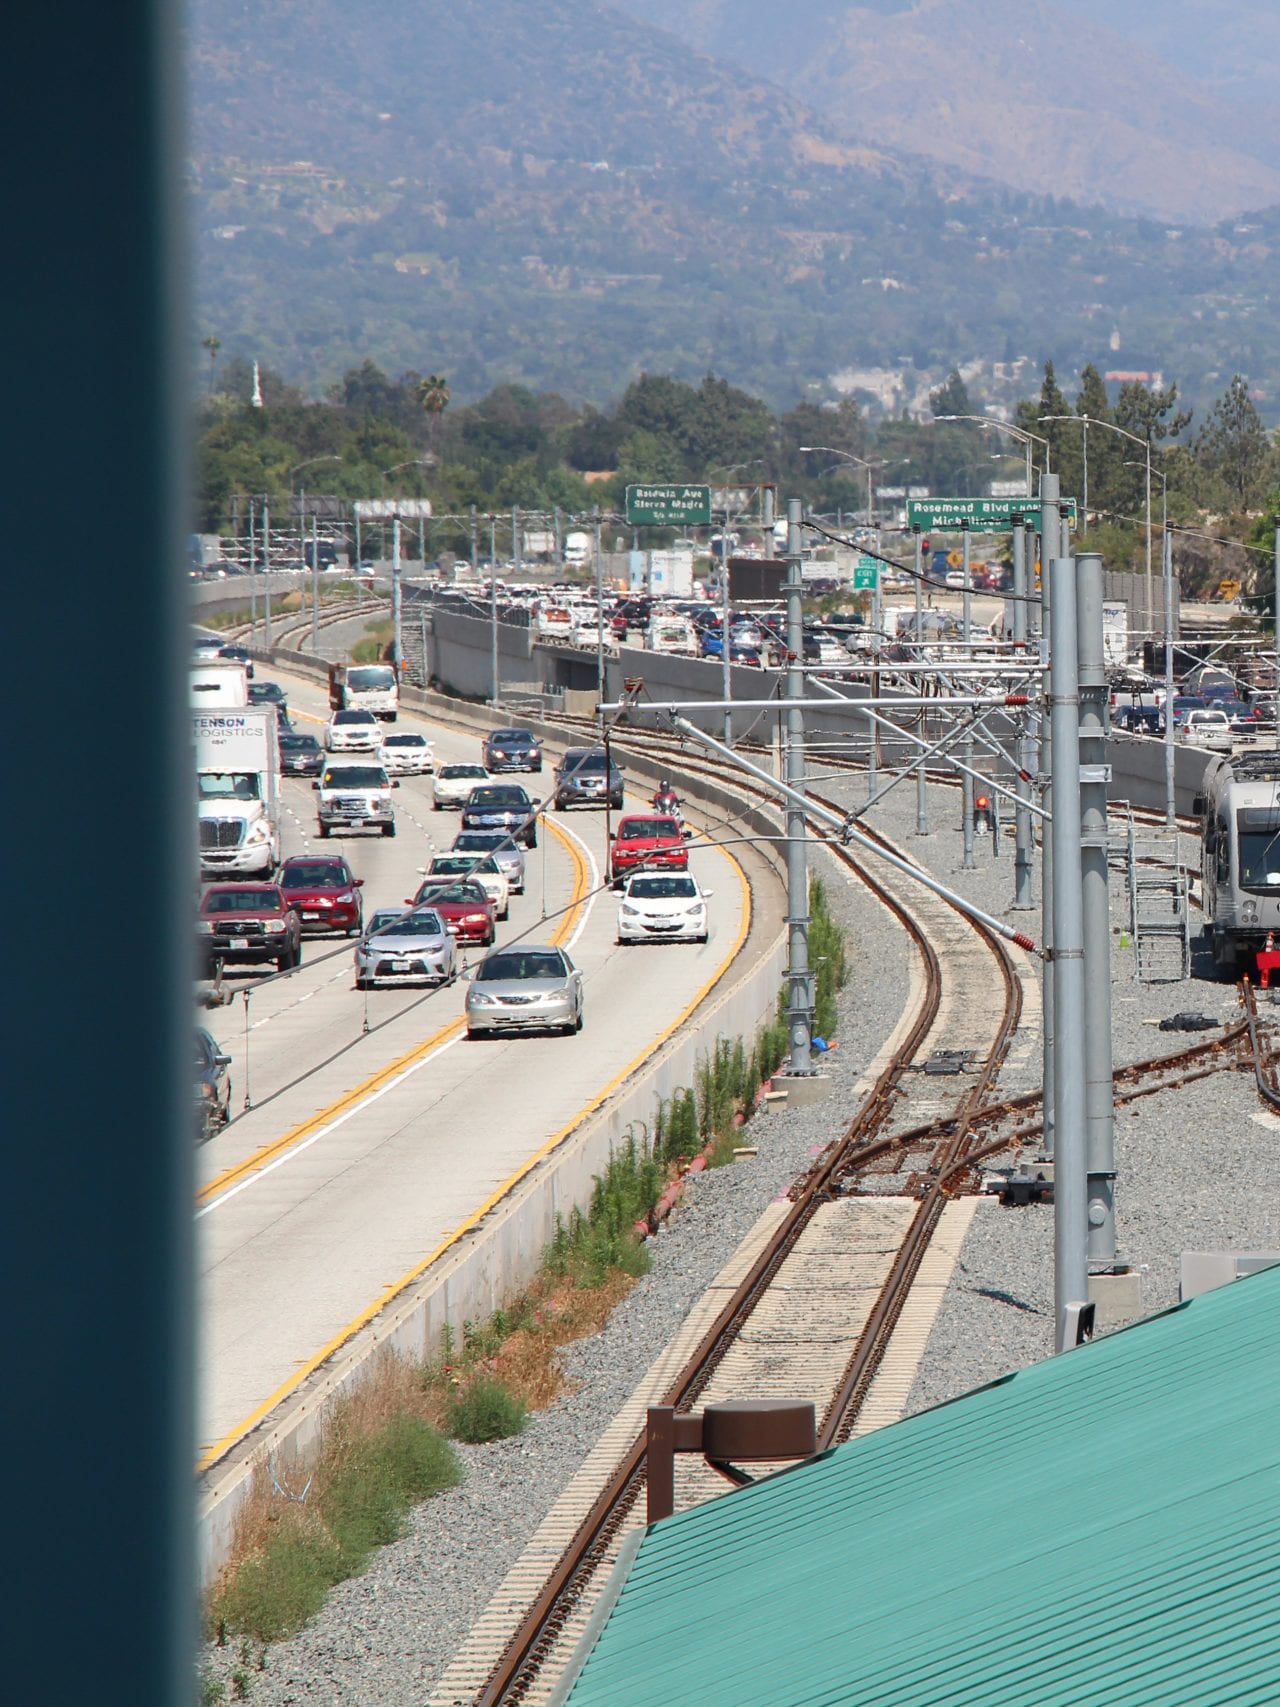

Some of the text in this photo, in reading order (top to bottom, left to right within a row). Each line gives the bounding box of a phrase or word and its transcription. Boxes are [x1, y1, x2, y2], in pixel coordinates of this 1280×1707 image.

[682, 489, 702, 498] Ave
[671, 500, 704, 510] Madre
[914, 503, 974, 512] Rosemead
[982, 503, 1009, 512] Blvd
[193, 728, 264, 737] LOGISTICS
